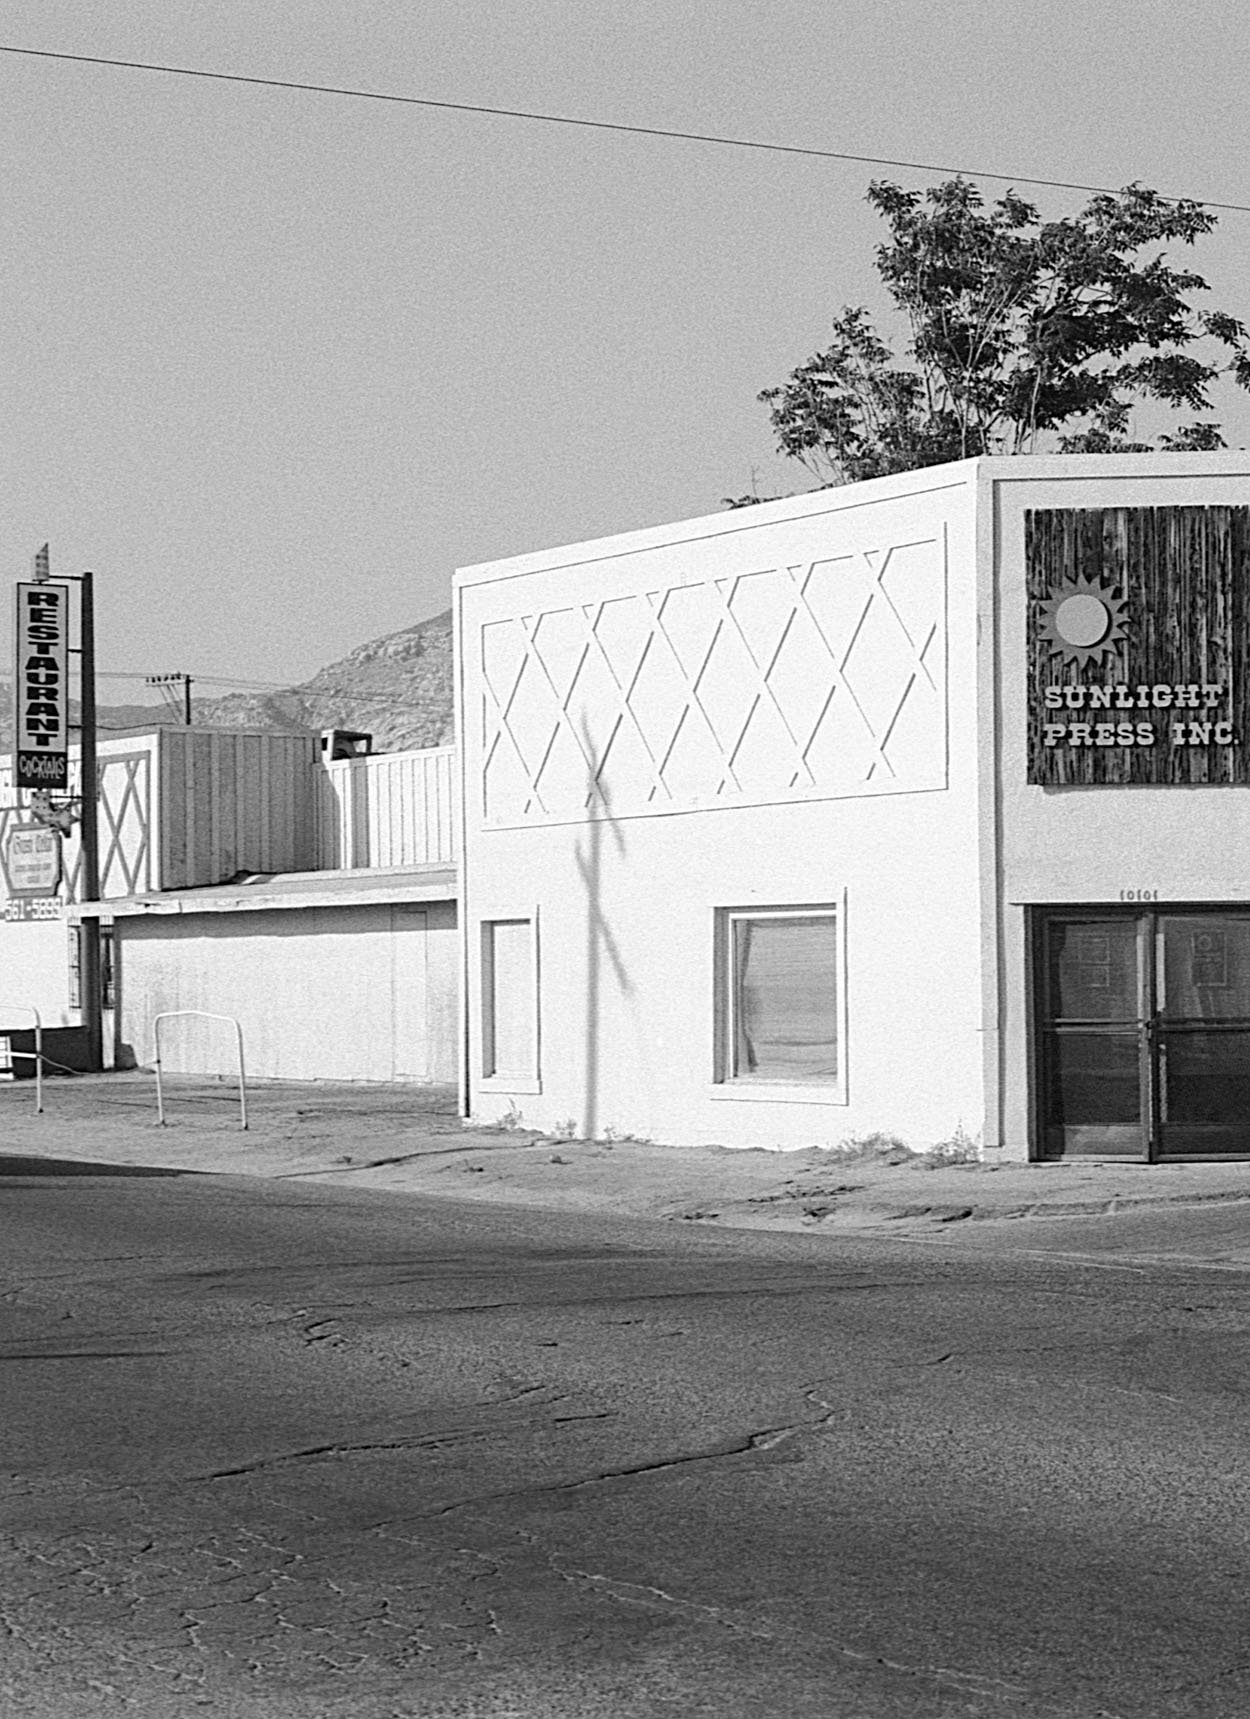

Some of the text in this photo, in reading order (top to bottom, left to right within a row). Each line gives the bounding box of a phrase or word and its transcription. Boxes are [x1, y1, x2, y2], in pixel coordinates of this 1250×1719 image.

[25, 591, 59, 747] RESTAURANT
[1044, 683, 1224, 709] SUNLIGHT
[1043, 721, 1239, 746] PRESS INC.
[19, 755, 65, 779] COCKTAILS
[1120, 889, 1158, 901] 10101
